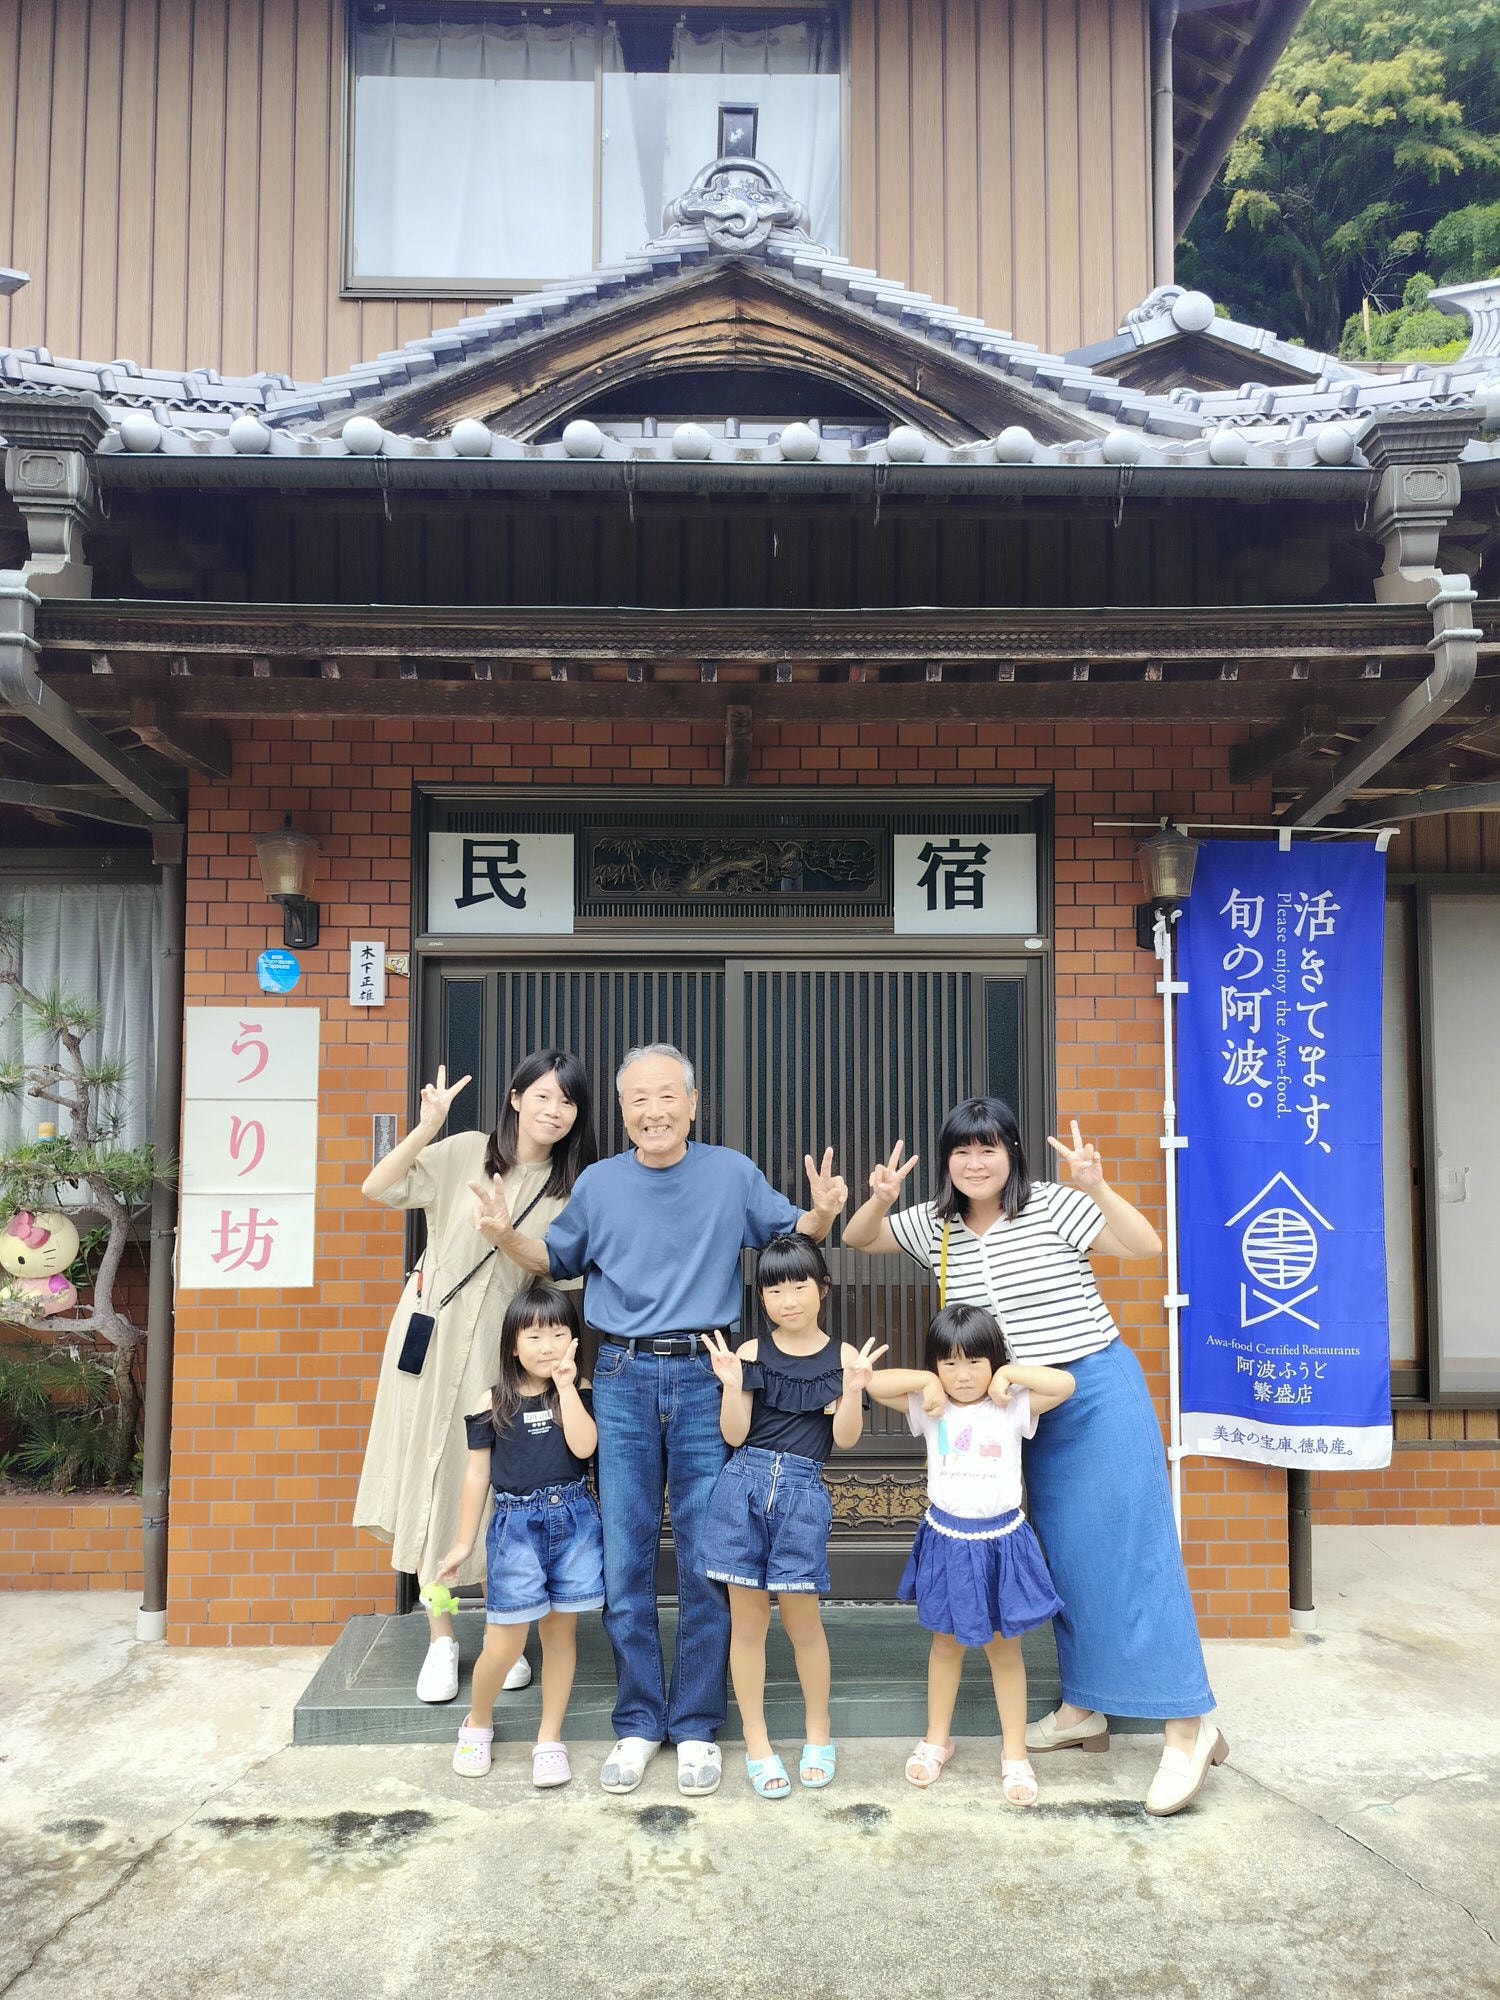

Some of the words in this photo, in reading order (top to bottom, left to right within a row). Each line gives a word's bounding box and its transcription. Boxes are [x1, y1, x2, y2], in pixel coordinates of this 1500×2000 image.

[455, 839, 527, 910] 民
[917, 838, 992, 911] 宿
[1276, 892, 1293, 943] Please
[359, 945, 376, 1001] 木下正雄
[1271, 948, 1291, 995] enjoy
[1219, 887, 1273, 1109] 旬の阿波。
[1276, 999, 1292, 1027] the
[1293, 889, 1341, 1154] 活きてます、
[1276, 1032, 1292, 1119] Awa-food.
[211, 1021, 279, 1273] うり坊
[1205, 1334, 1253, 1353] Awa-food
[1255, 1343, 1300, 1356] Certified
[1302, 1344, 1361, 1356] Restaurants
[1236, 1355, 1328, 1380] 阿波ふうど
[1252, 1380, 1313, 1405] 繁盛店
[1212, 1425, 1354, 1456] 美食の宝庫、徳島産。
